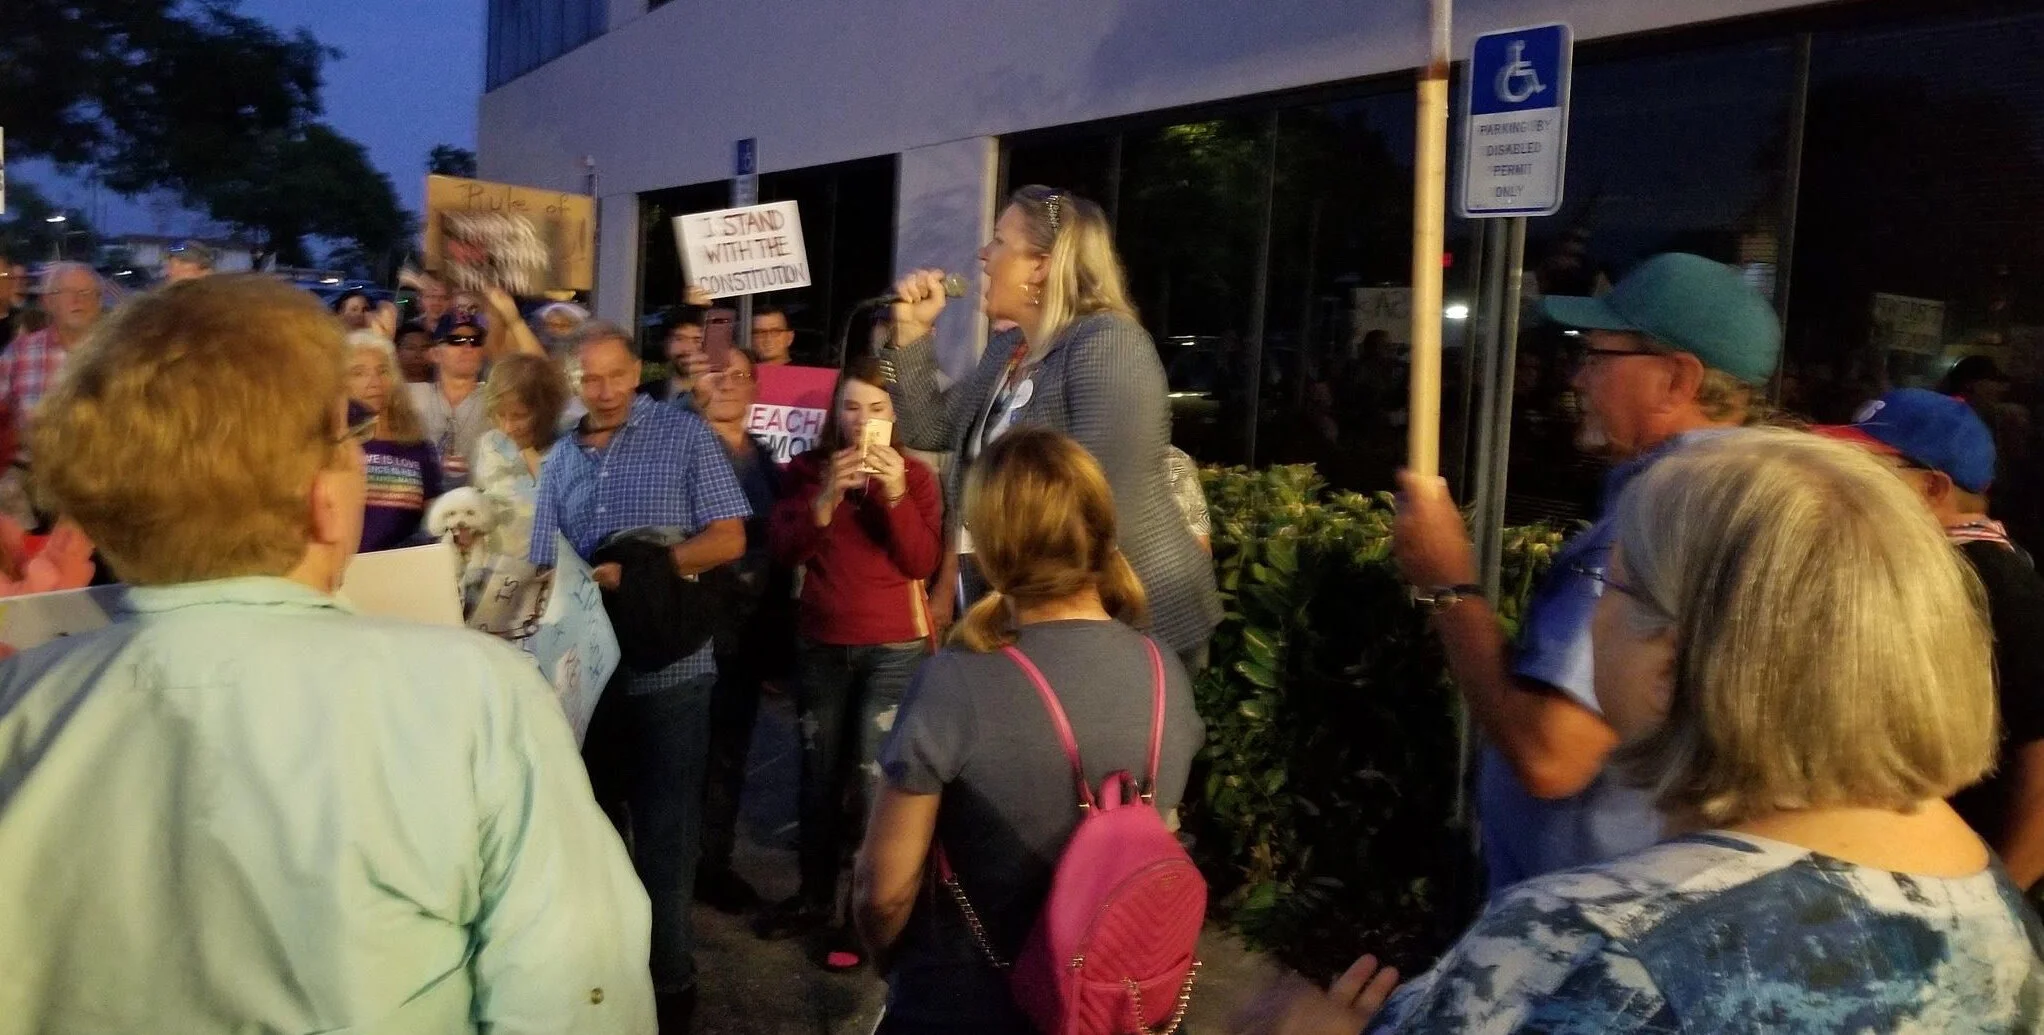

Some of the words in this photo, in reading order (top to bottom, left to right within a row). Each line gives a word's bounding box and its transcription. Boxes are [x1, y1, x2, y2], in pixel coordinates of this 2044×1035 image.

[1480, 122, 1528, 135] PARKING
[1536, 119, 1553, 131] BY
[1486, 142, 1541, 156] DISABLED
[1493, 163, 1533, 176] PERMIT
[1496, 185, 1525, 197] ONLY
[546, 193, 571, 216] of
[724, 209, 785, 236] STAND
[703, 240, 753, 264] WITH
[756, 236, 793, 258] THE
[698, 263, 808, 294] CONSTITUTION
[748, 407, 822, 434] EACH
